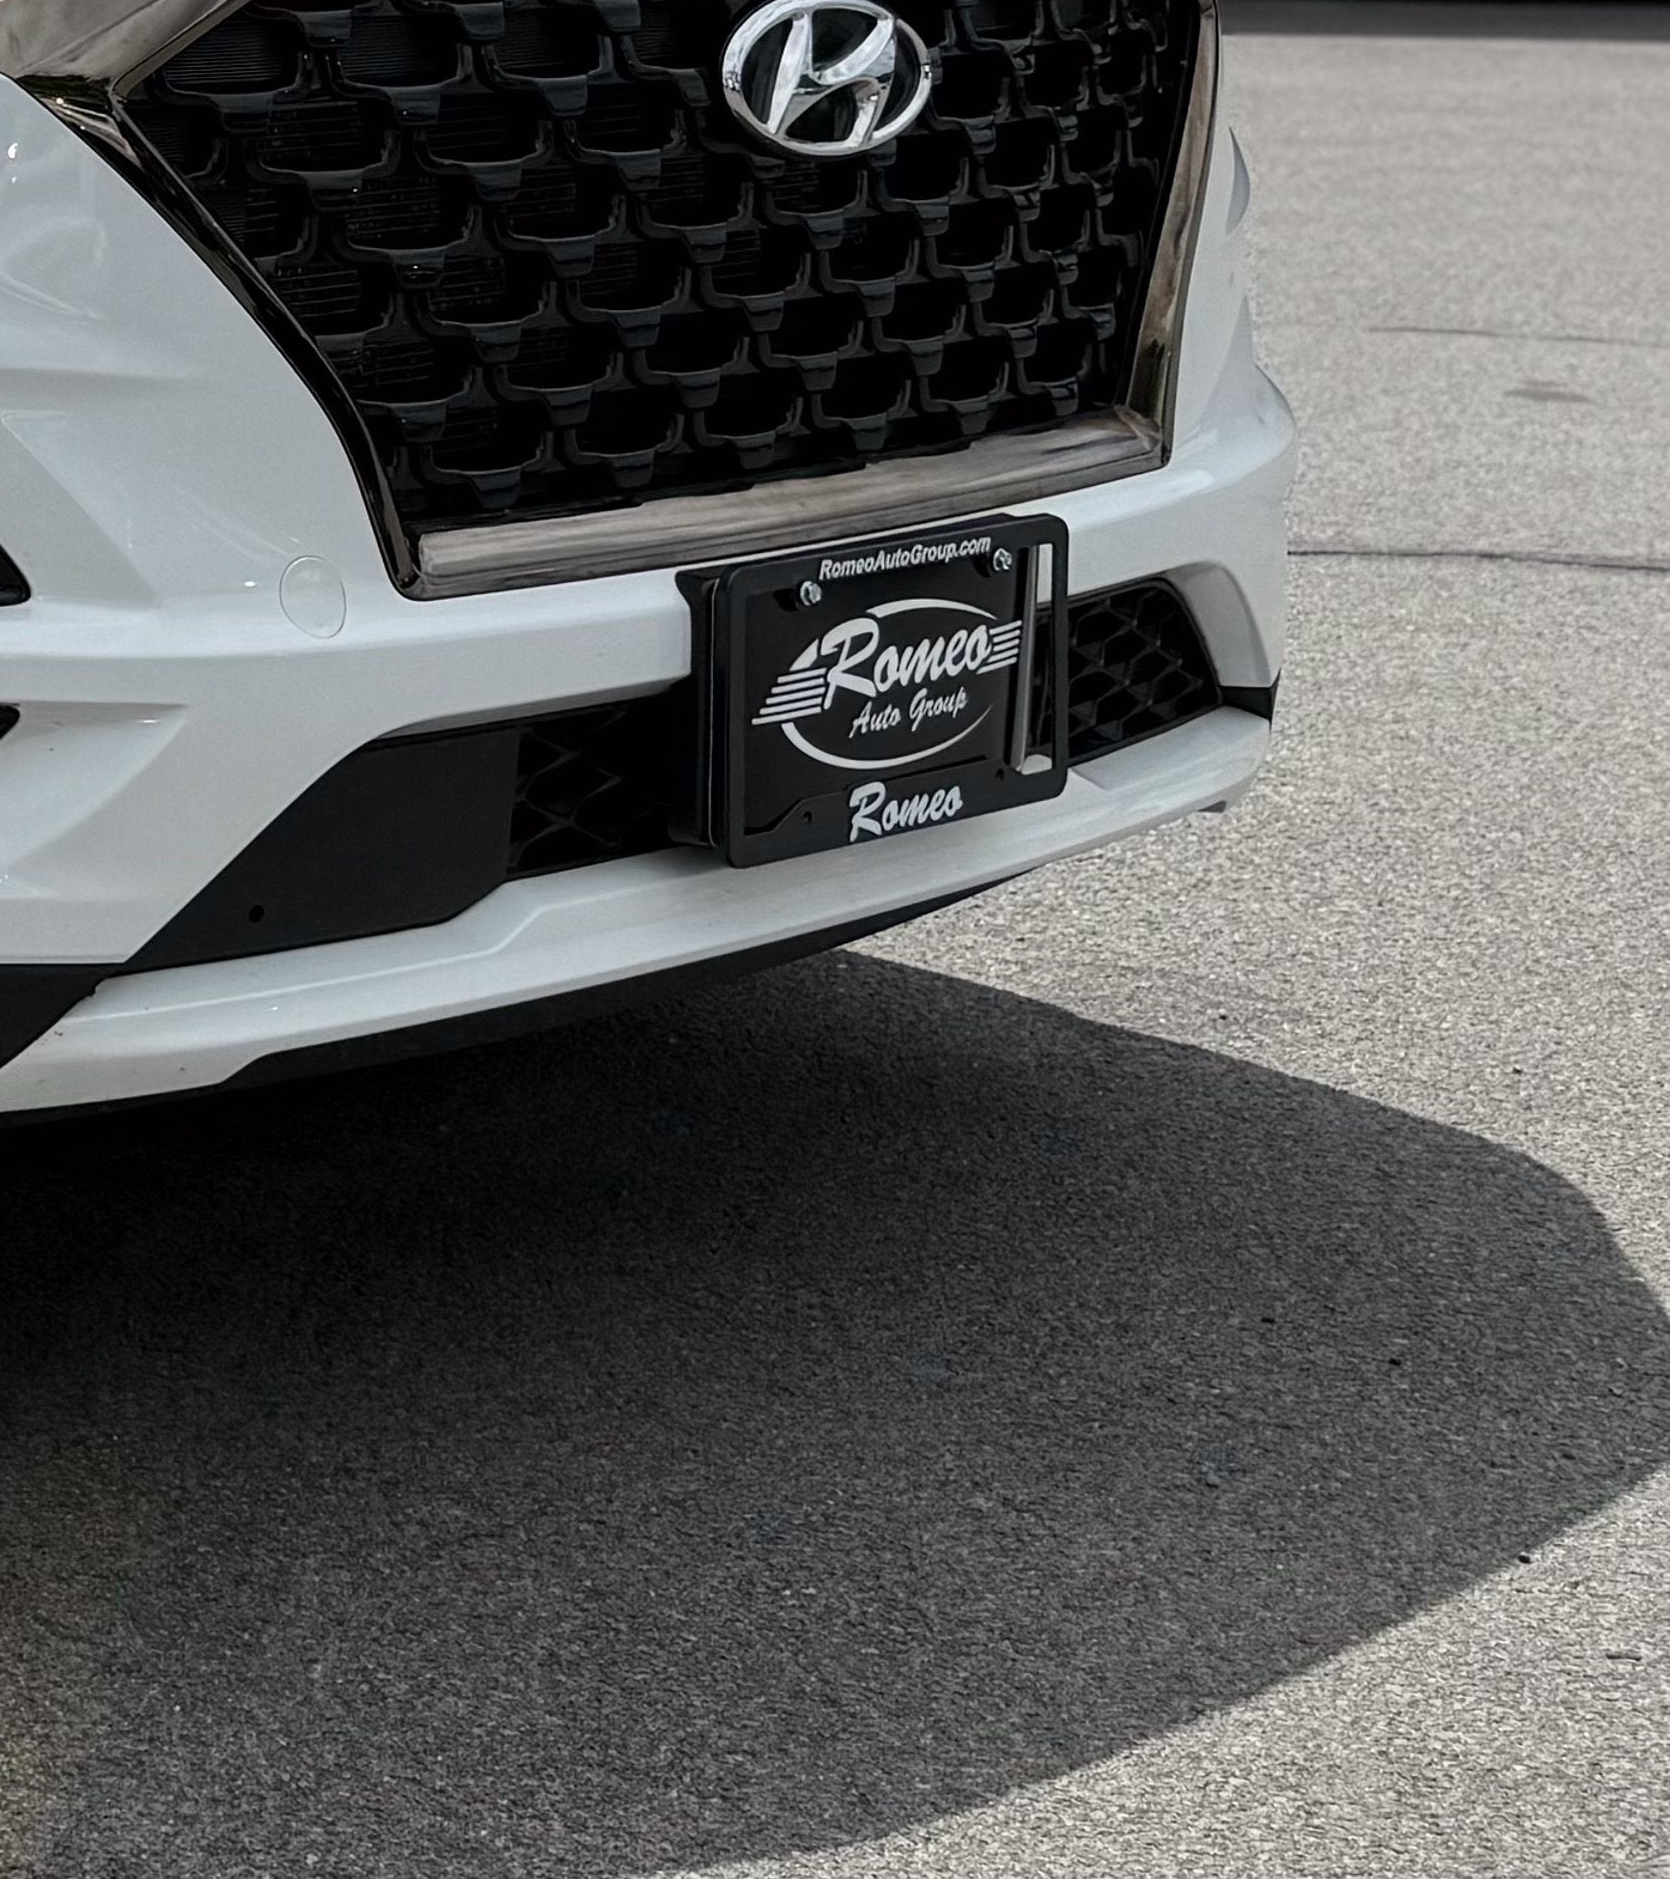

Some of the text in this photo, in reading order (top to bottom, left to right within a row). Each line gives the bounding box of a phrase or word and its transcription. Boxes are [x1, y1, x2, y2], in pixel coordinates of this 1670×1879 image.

[818, 536, 992, 581] RomeoAutoGroup.com
[820, 617, 993, 710] Romeo
[849, 686, 969, 740] Auto Group
[849, 781, 963, 842] Romeo
